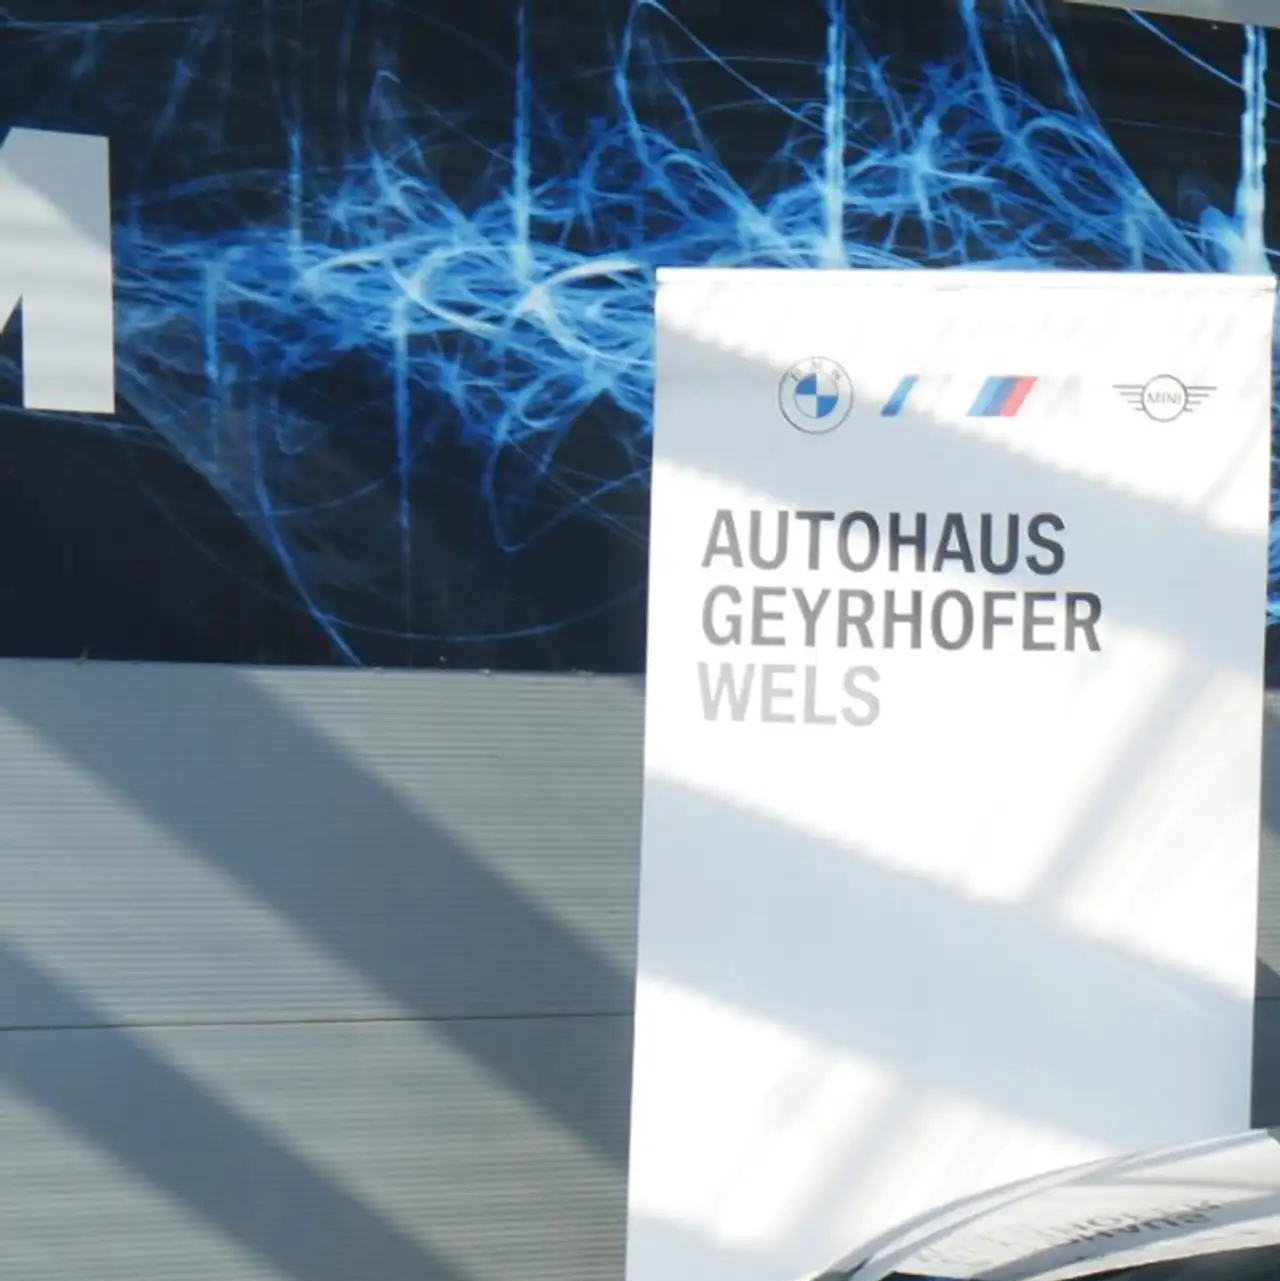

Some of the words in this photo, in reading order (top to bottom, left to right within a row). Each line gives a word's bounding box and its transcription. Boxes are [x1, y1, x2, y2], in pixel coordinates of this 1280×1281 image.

[1146, 391, 1183, 405] MINI
[701, 508, 1066, 576] AUTOHAUS
[701, 585, 1102, 652] GEYRHOFER
[697, 661, 881, 726] WELS
